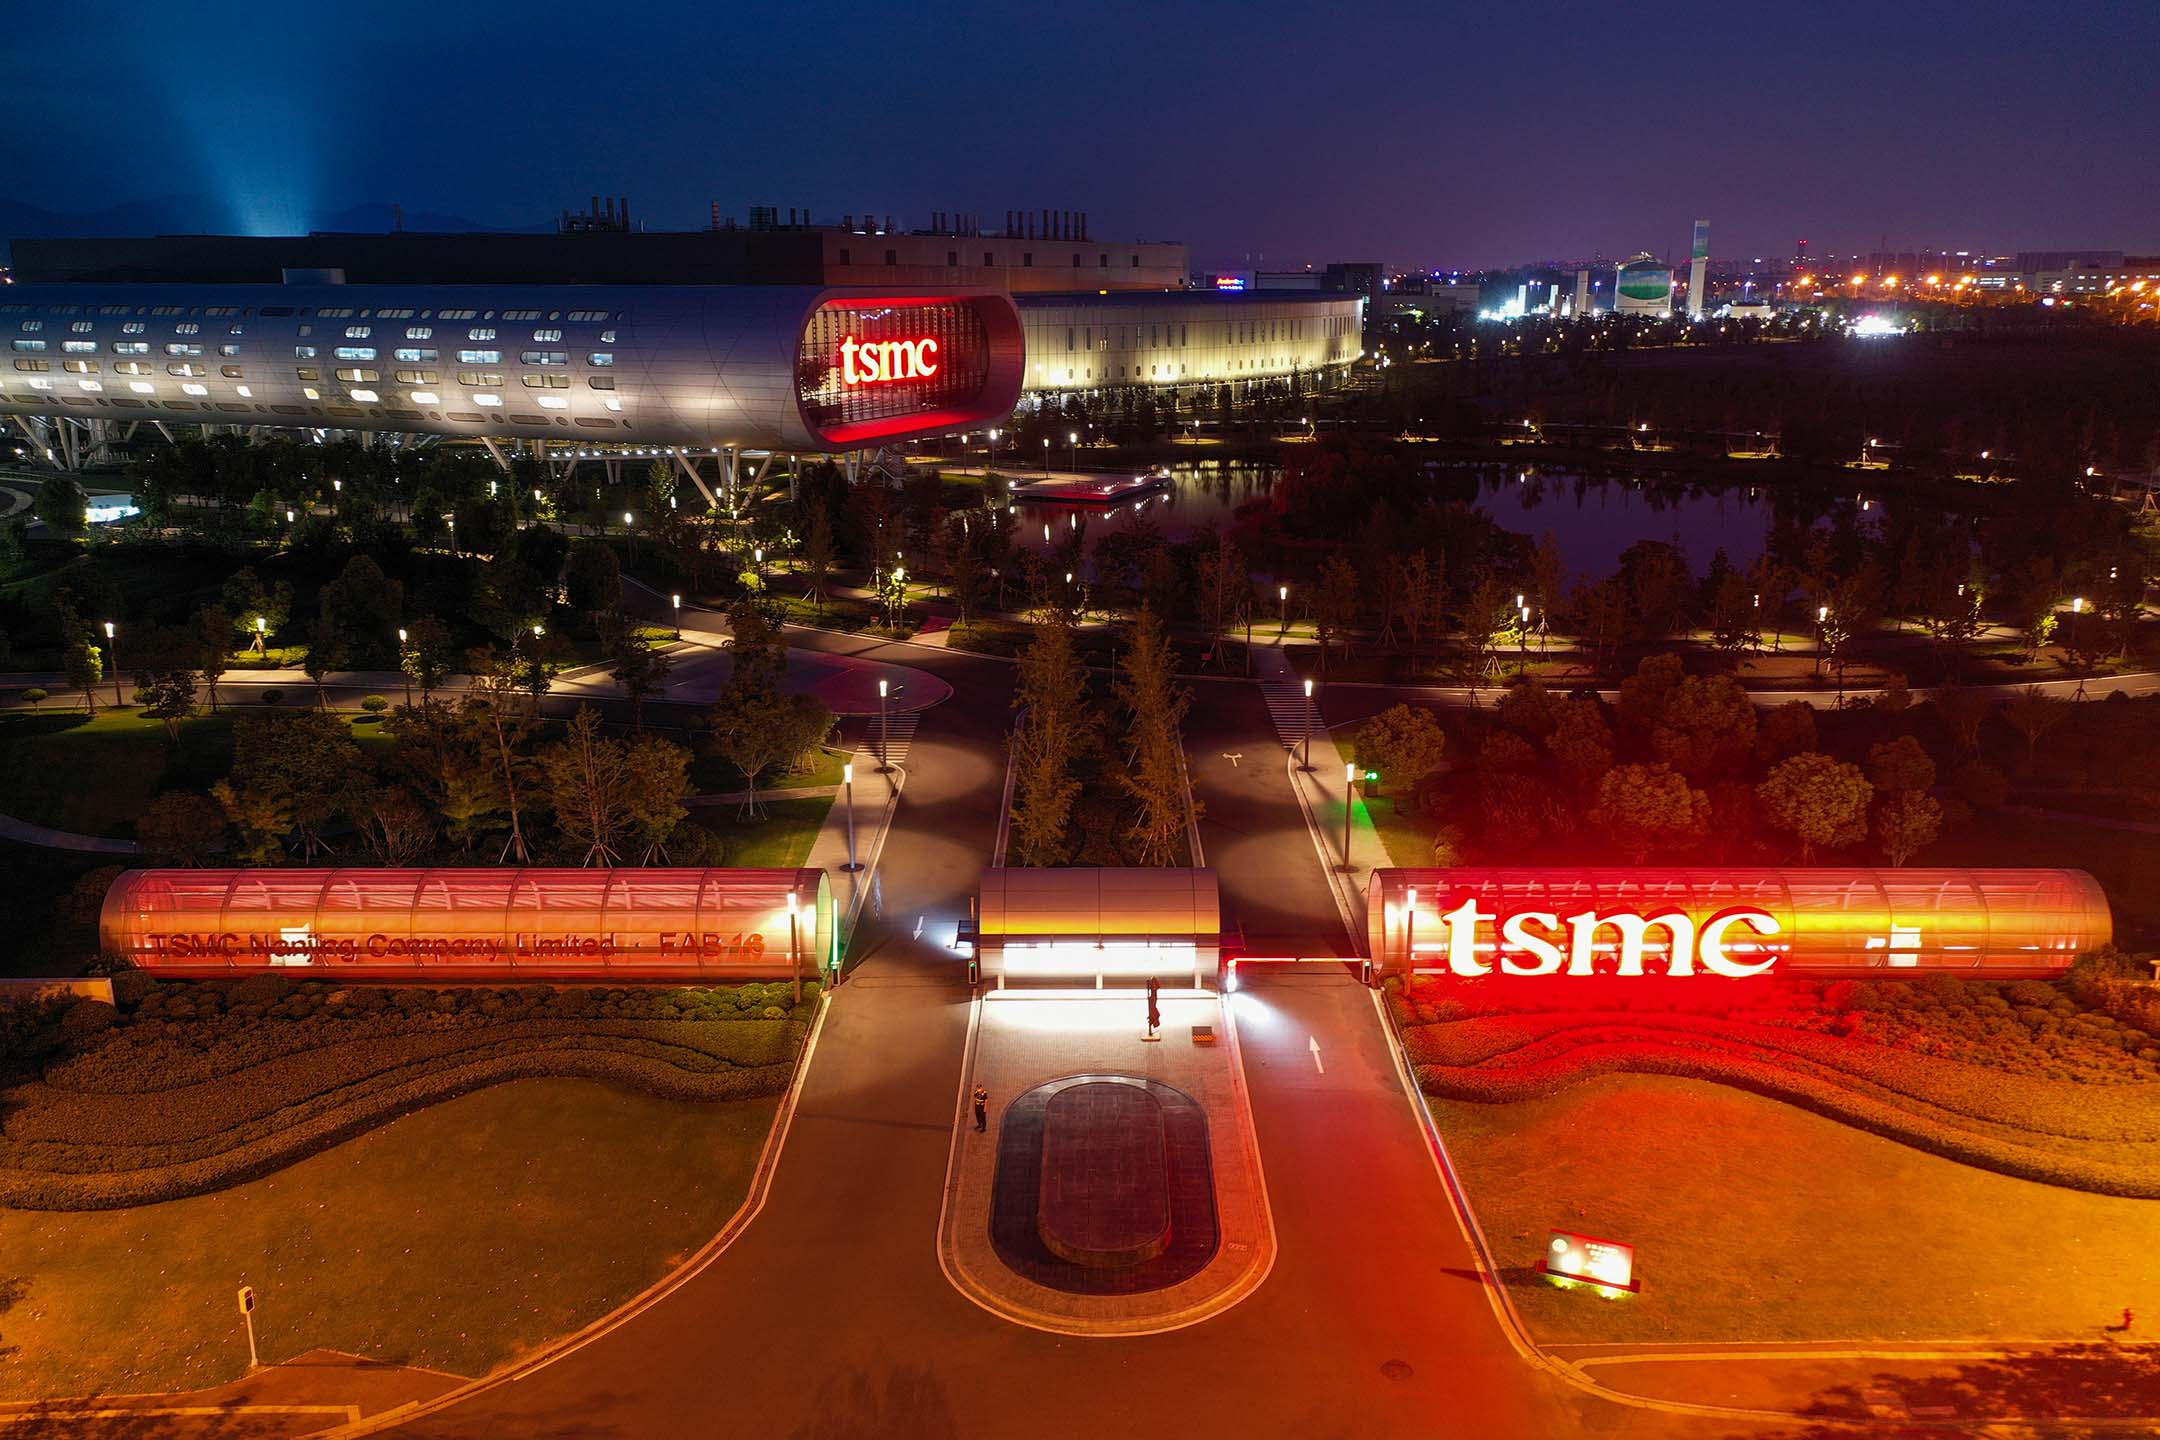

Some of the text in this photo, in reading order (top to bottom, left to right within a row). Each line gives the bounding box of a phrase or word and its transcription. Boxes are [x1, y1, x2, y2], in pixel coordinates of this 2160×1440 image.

[840, 336, 938, 384] tsmc
[149, 933, 240, 958] TSMC
[249, 933, 357, 962] Nanjing
[367, 933, 502, 962] Company
[516, 932, 617, 957] Limited
[659, 932, 722, 957] FAB
[1442, 898, 1781, 977] tsmc
